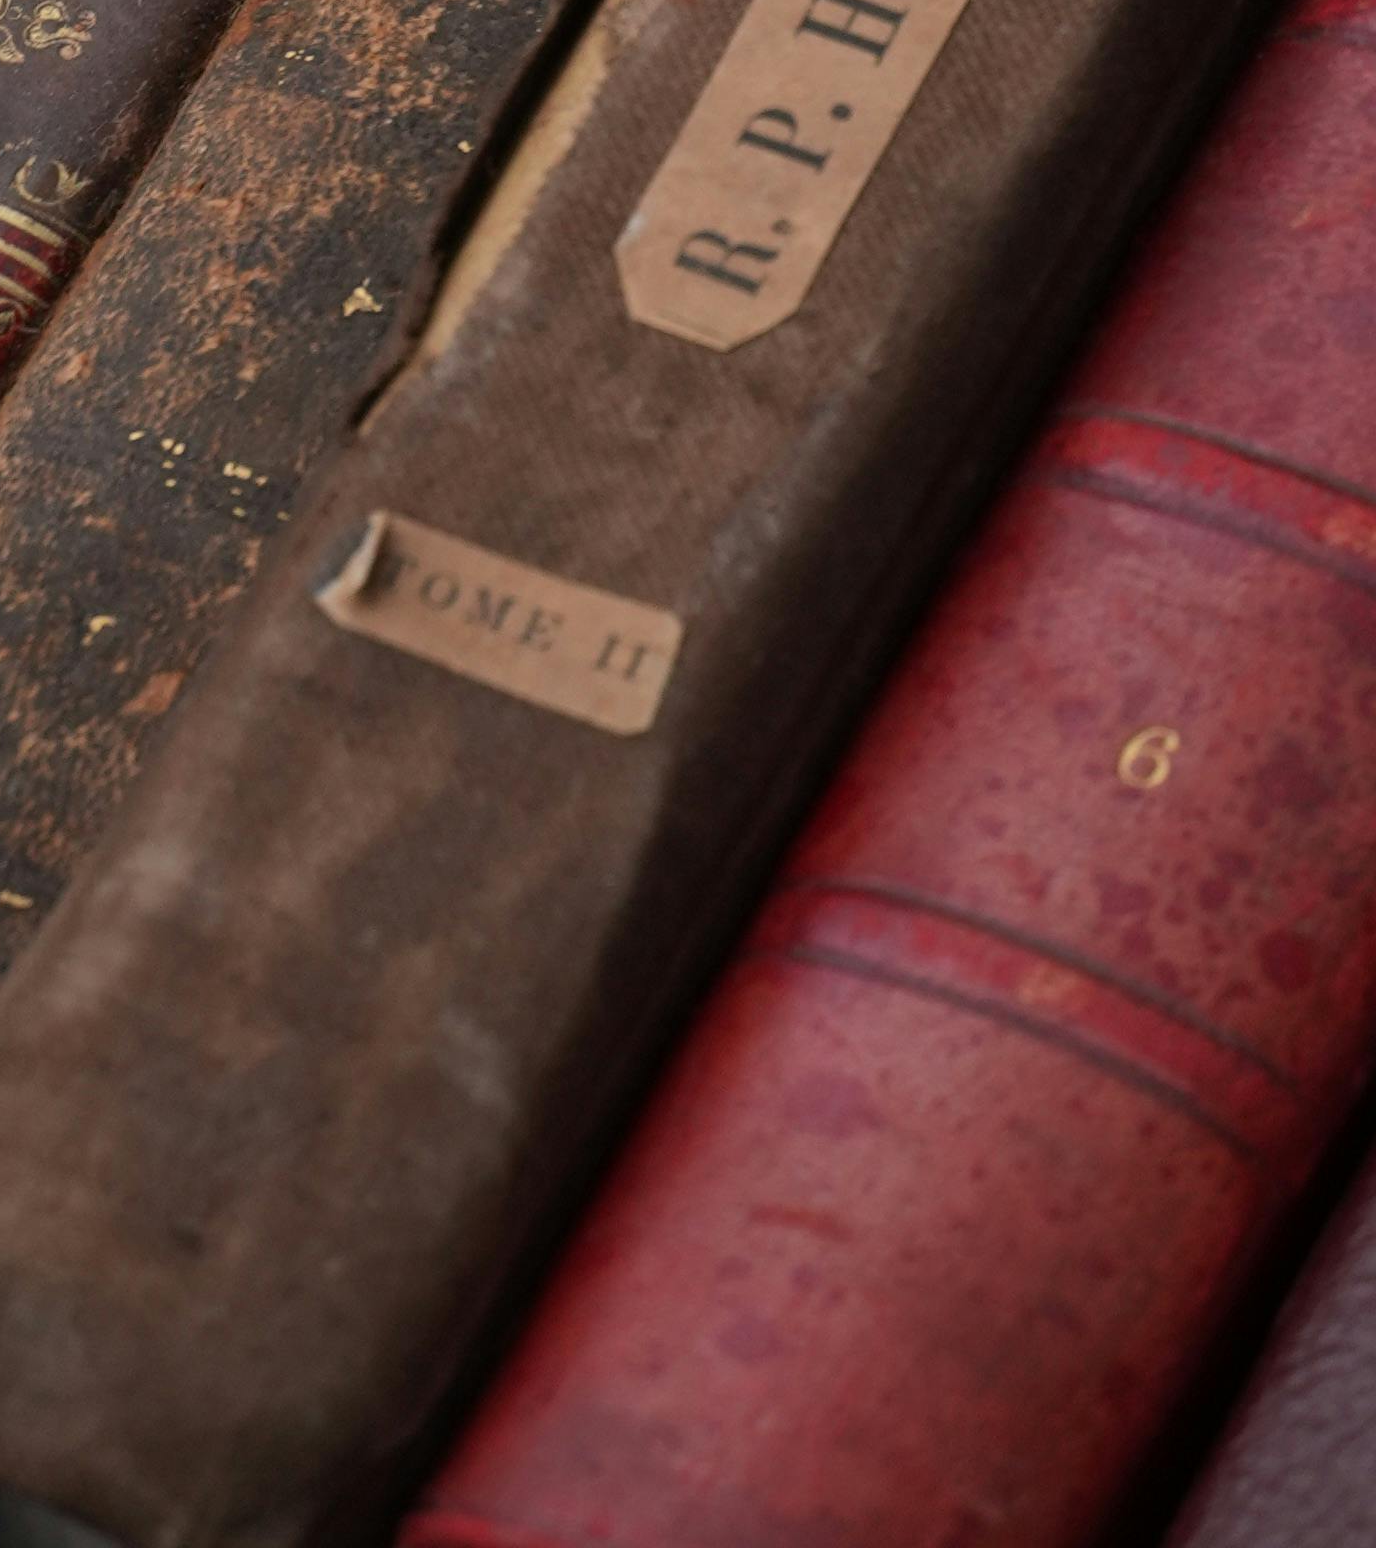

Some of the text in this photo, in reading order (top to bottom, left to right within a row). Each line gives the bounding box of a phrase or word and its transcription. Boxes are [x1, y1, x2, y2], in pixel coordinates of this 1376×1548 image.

[673, 216, 797, 300] R.
[736, 98, 855, 176] P.
[1118, 725, 1181, 790] 6
